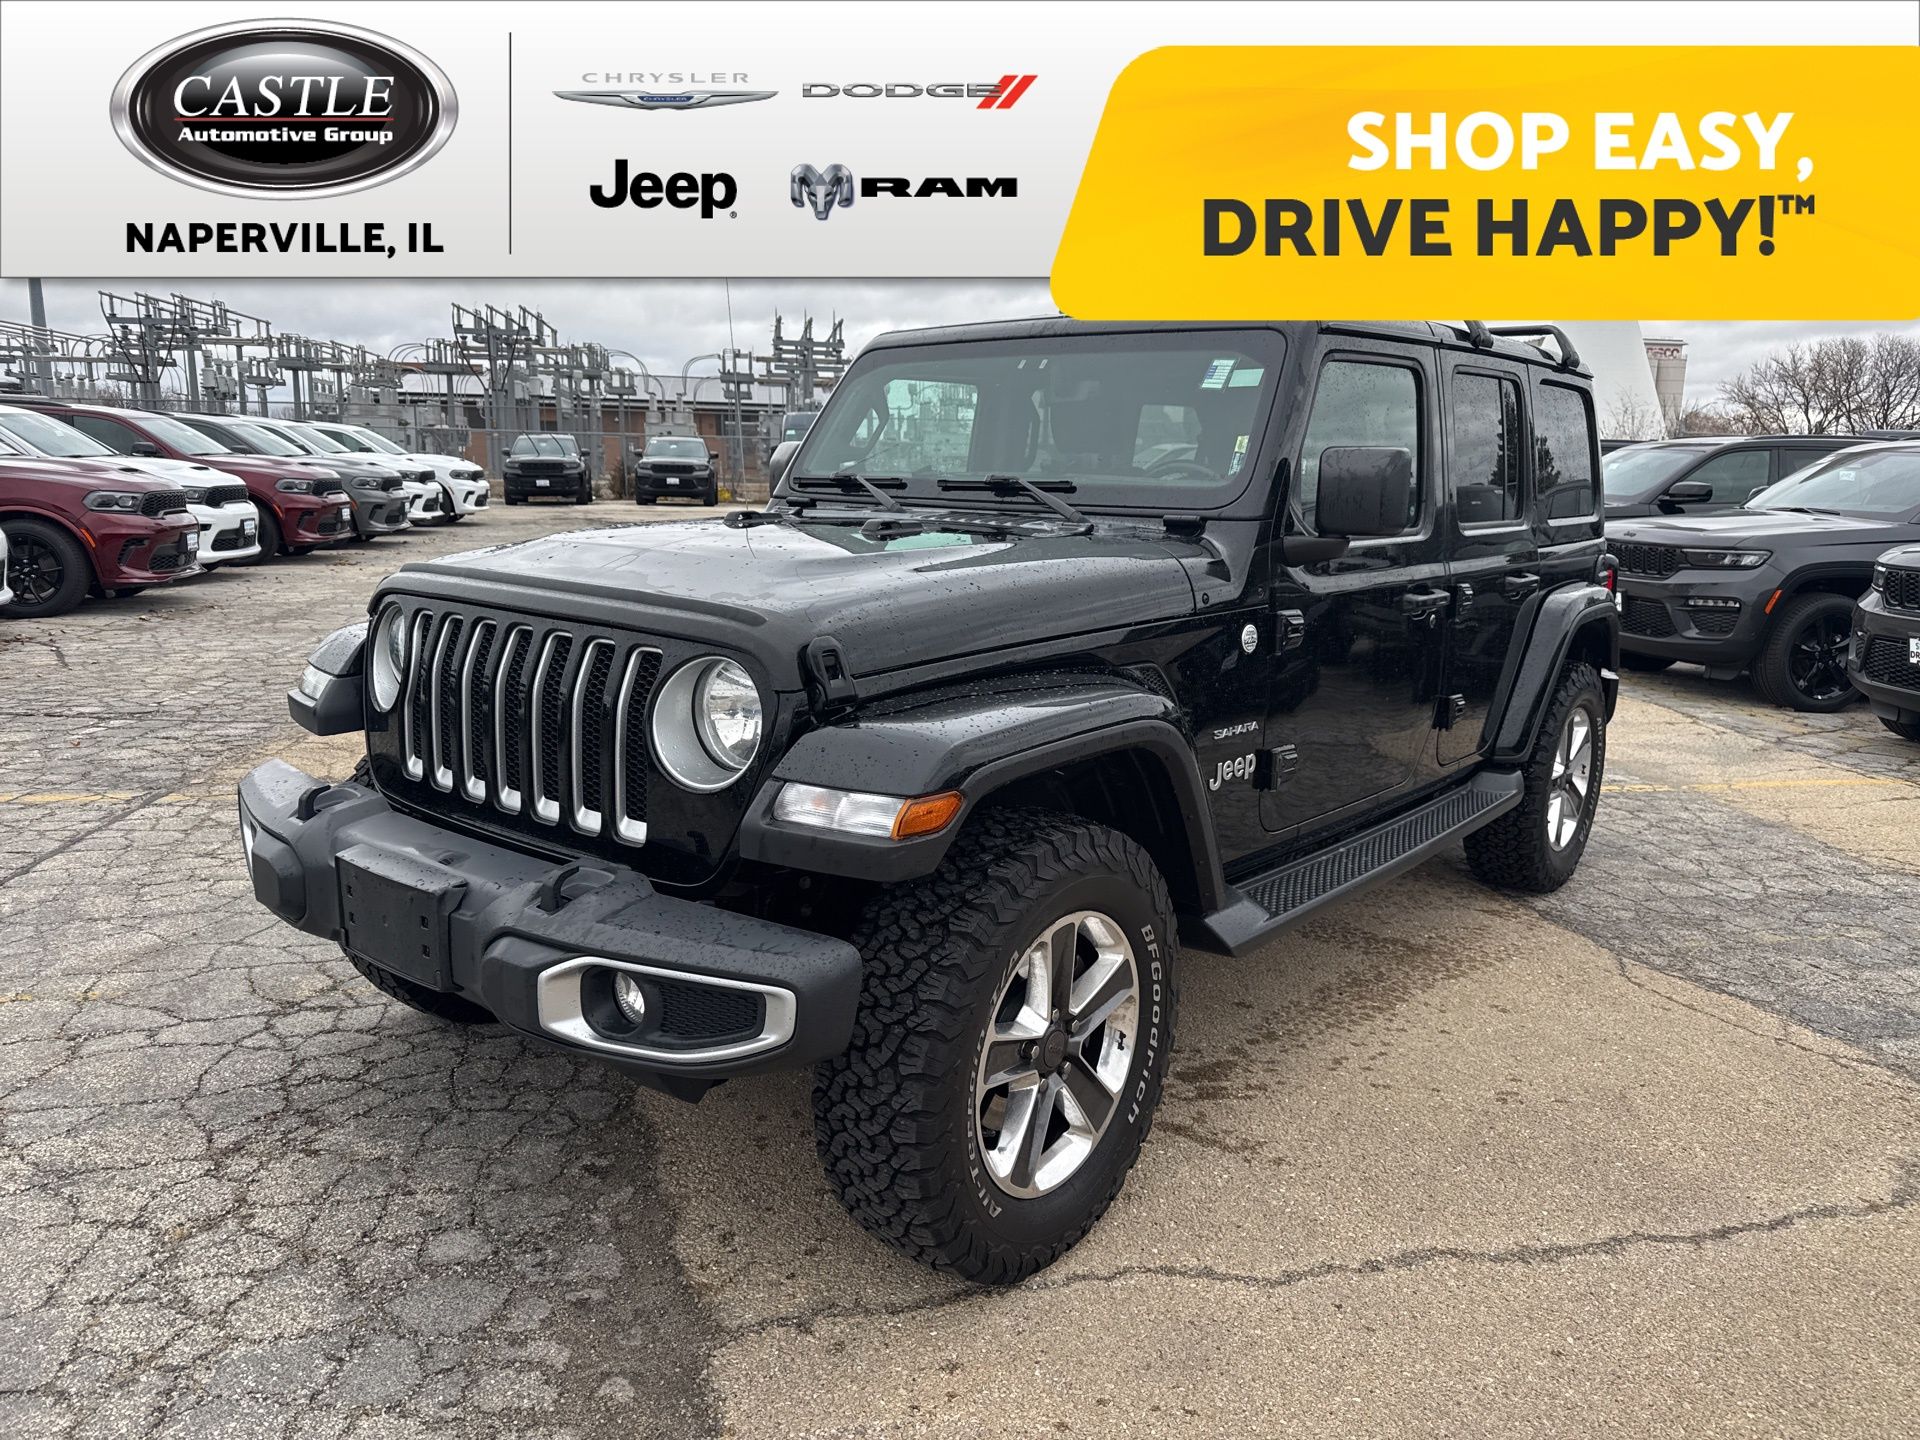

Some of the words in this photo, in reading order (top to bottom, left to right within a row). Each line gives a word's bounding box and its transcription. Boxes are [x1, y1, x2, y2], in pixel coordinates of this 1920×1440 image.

[1213, 720, 1259, 740] SAHARA
[1209, 753, 1257, 791] Jeep
[1128, 924, 1162, 1124] BFGoodrich
